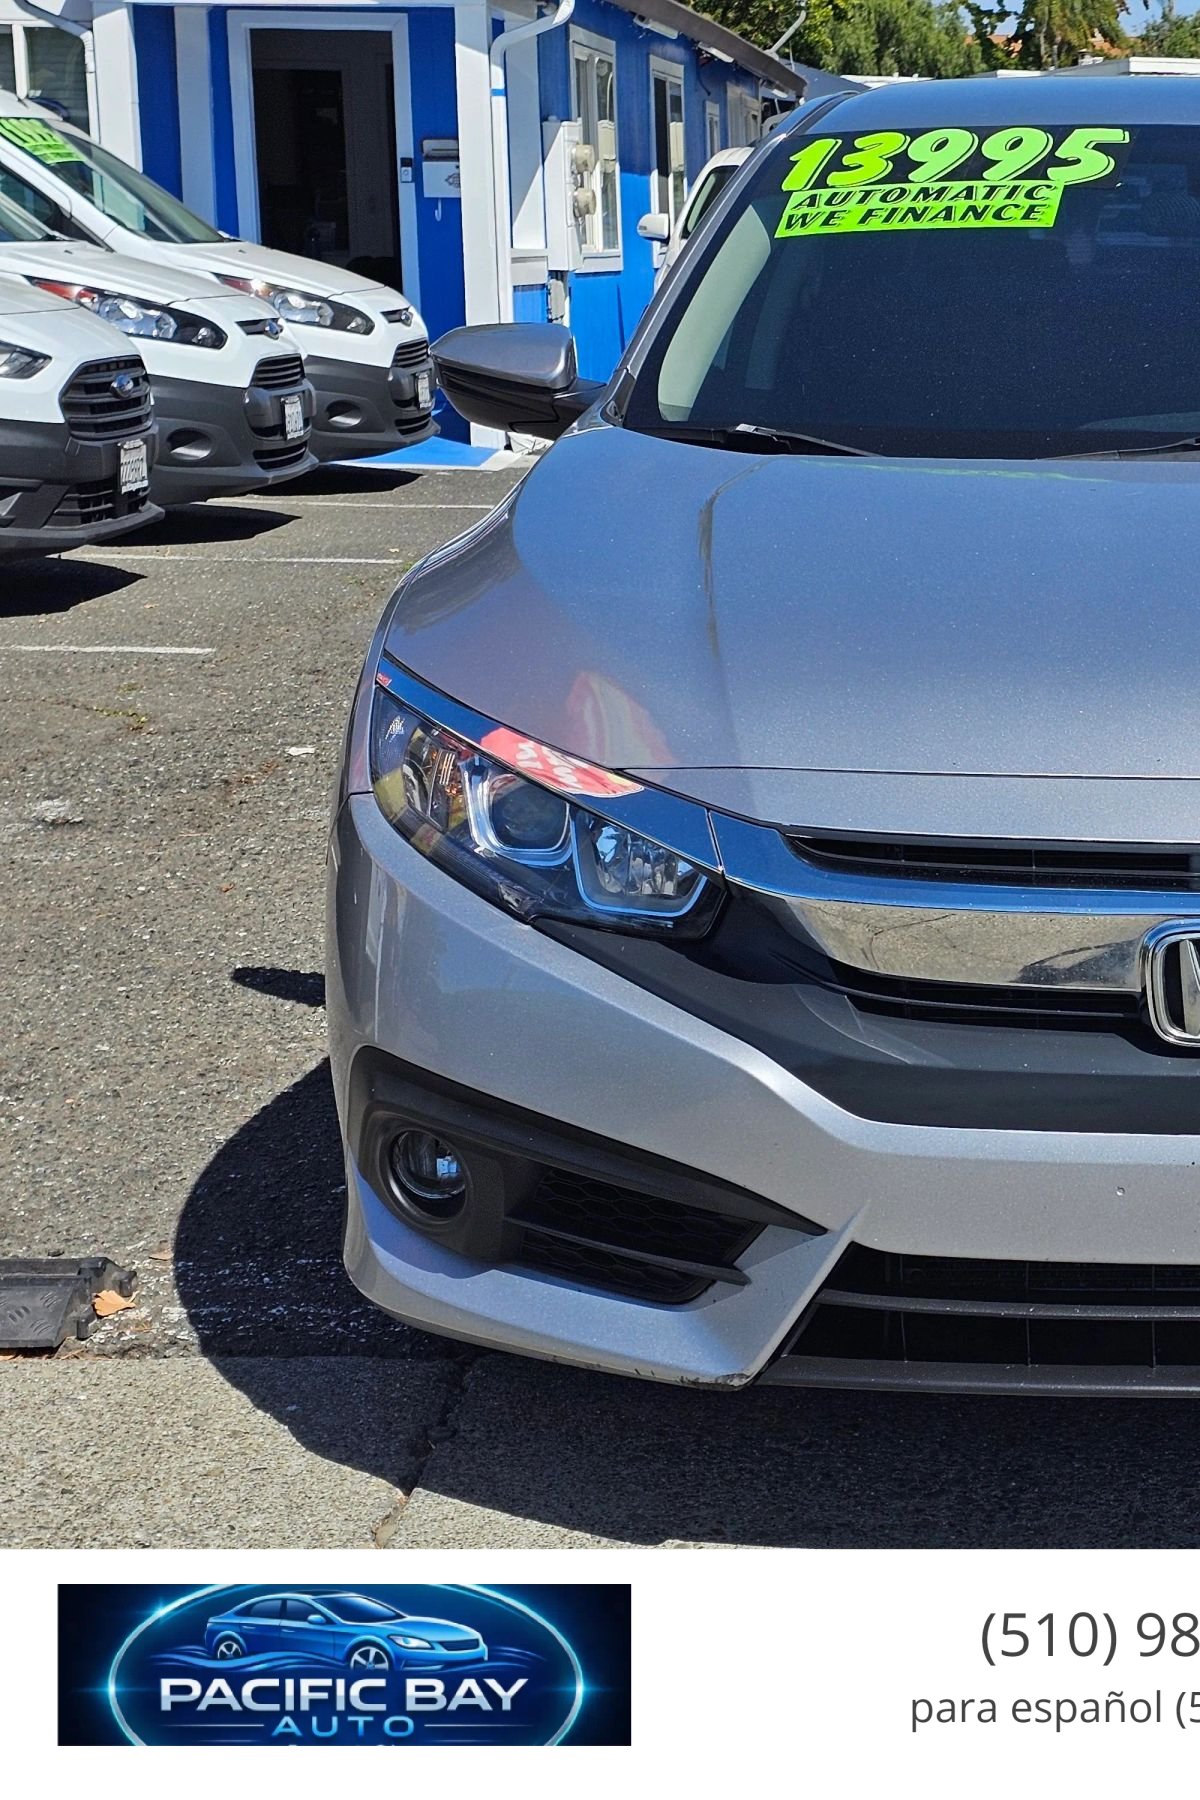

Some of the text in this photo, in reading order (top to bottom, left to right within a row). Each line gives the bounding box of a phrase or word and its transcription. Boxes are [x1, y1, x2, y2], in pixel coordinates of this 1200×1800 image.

[782, 128, 1130, 191] 13995
[791, 183, 1056, 211] AUTOMATIC
[785, 203, 1046, 231] WE FINANCE
